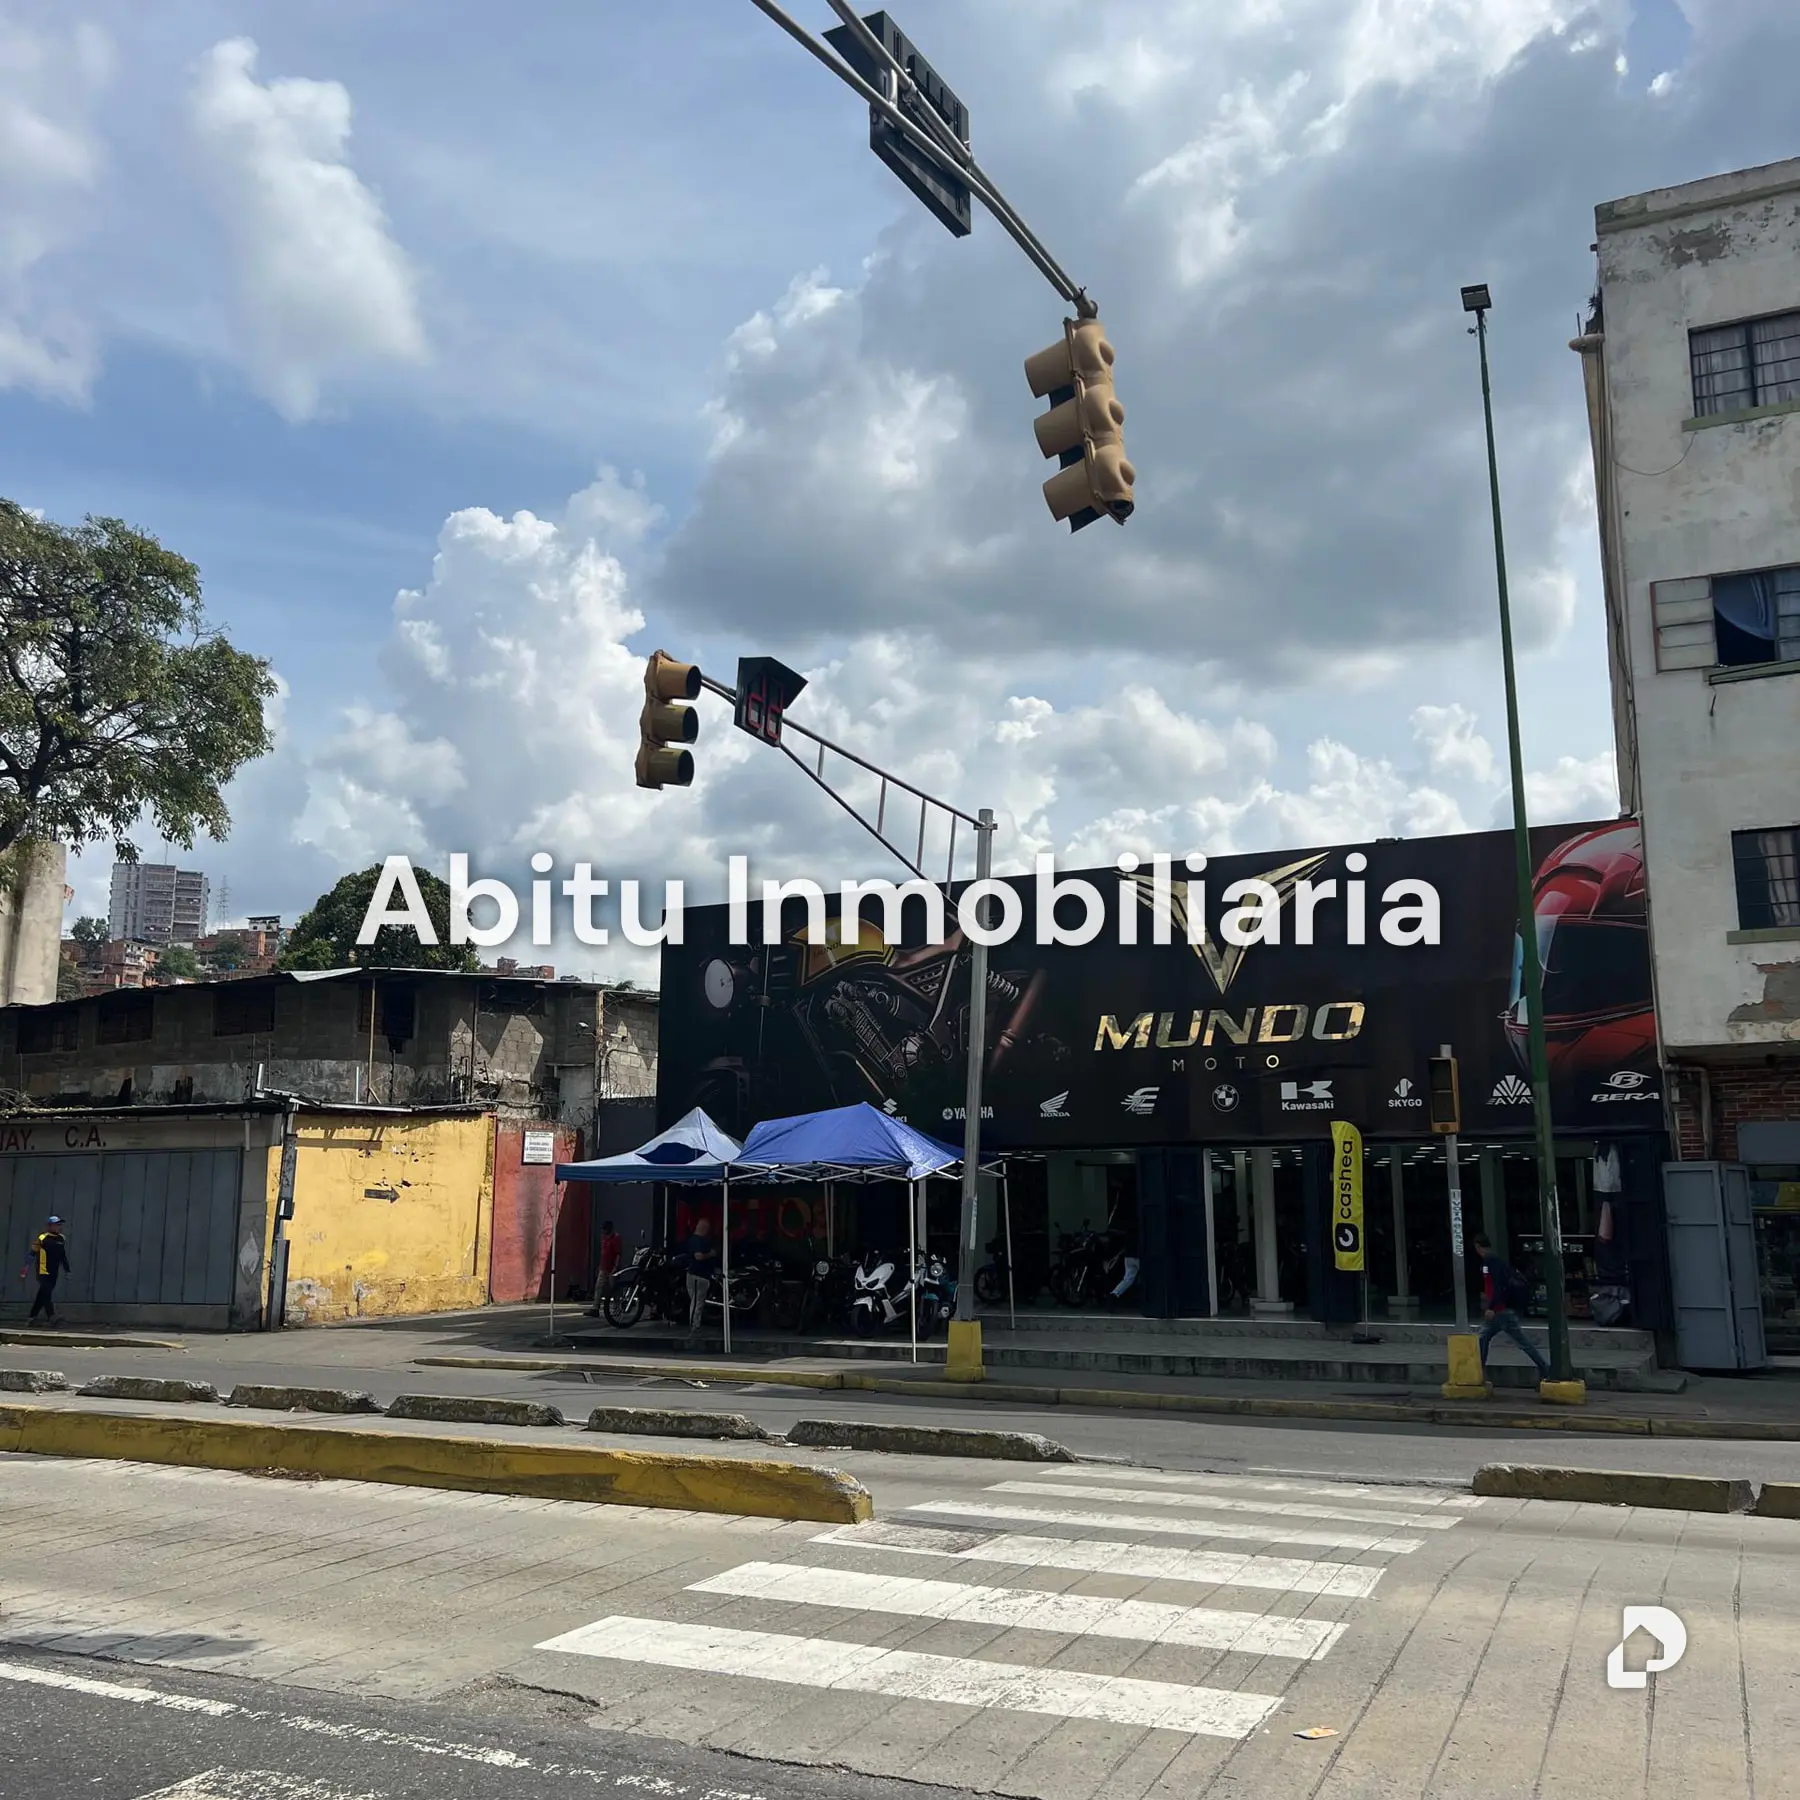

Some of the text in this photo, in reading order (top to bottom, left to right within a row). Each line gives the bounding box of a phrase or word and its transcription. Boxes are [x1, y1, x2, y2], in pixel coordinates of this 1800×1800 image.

[1094, 1001, 1366, 1051] MUNDO
[1172, 1054, 1280, 1072] MOTO
[1387, 1098, 1423, 1108] SKYGO
[1494, 1096, 1531, 1106] AVA
[1590, 1092, 1660, 1103] BERA
[1281, 1100, 1334, 1111] Kawasaki
[953, 1106, 994, 1120] YAHA
[65, 1125, 107, 1149] C.A.
[1339, 1140, 1353, 1220] cashea
